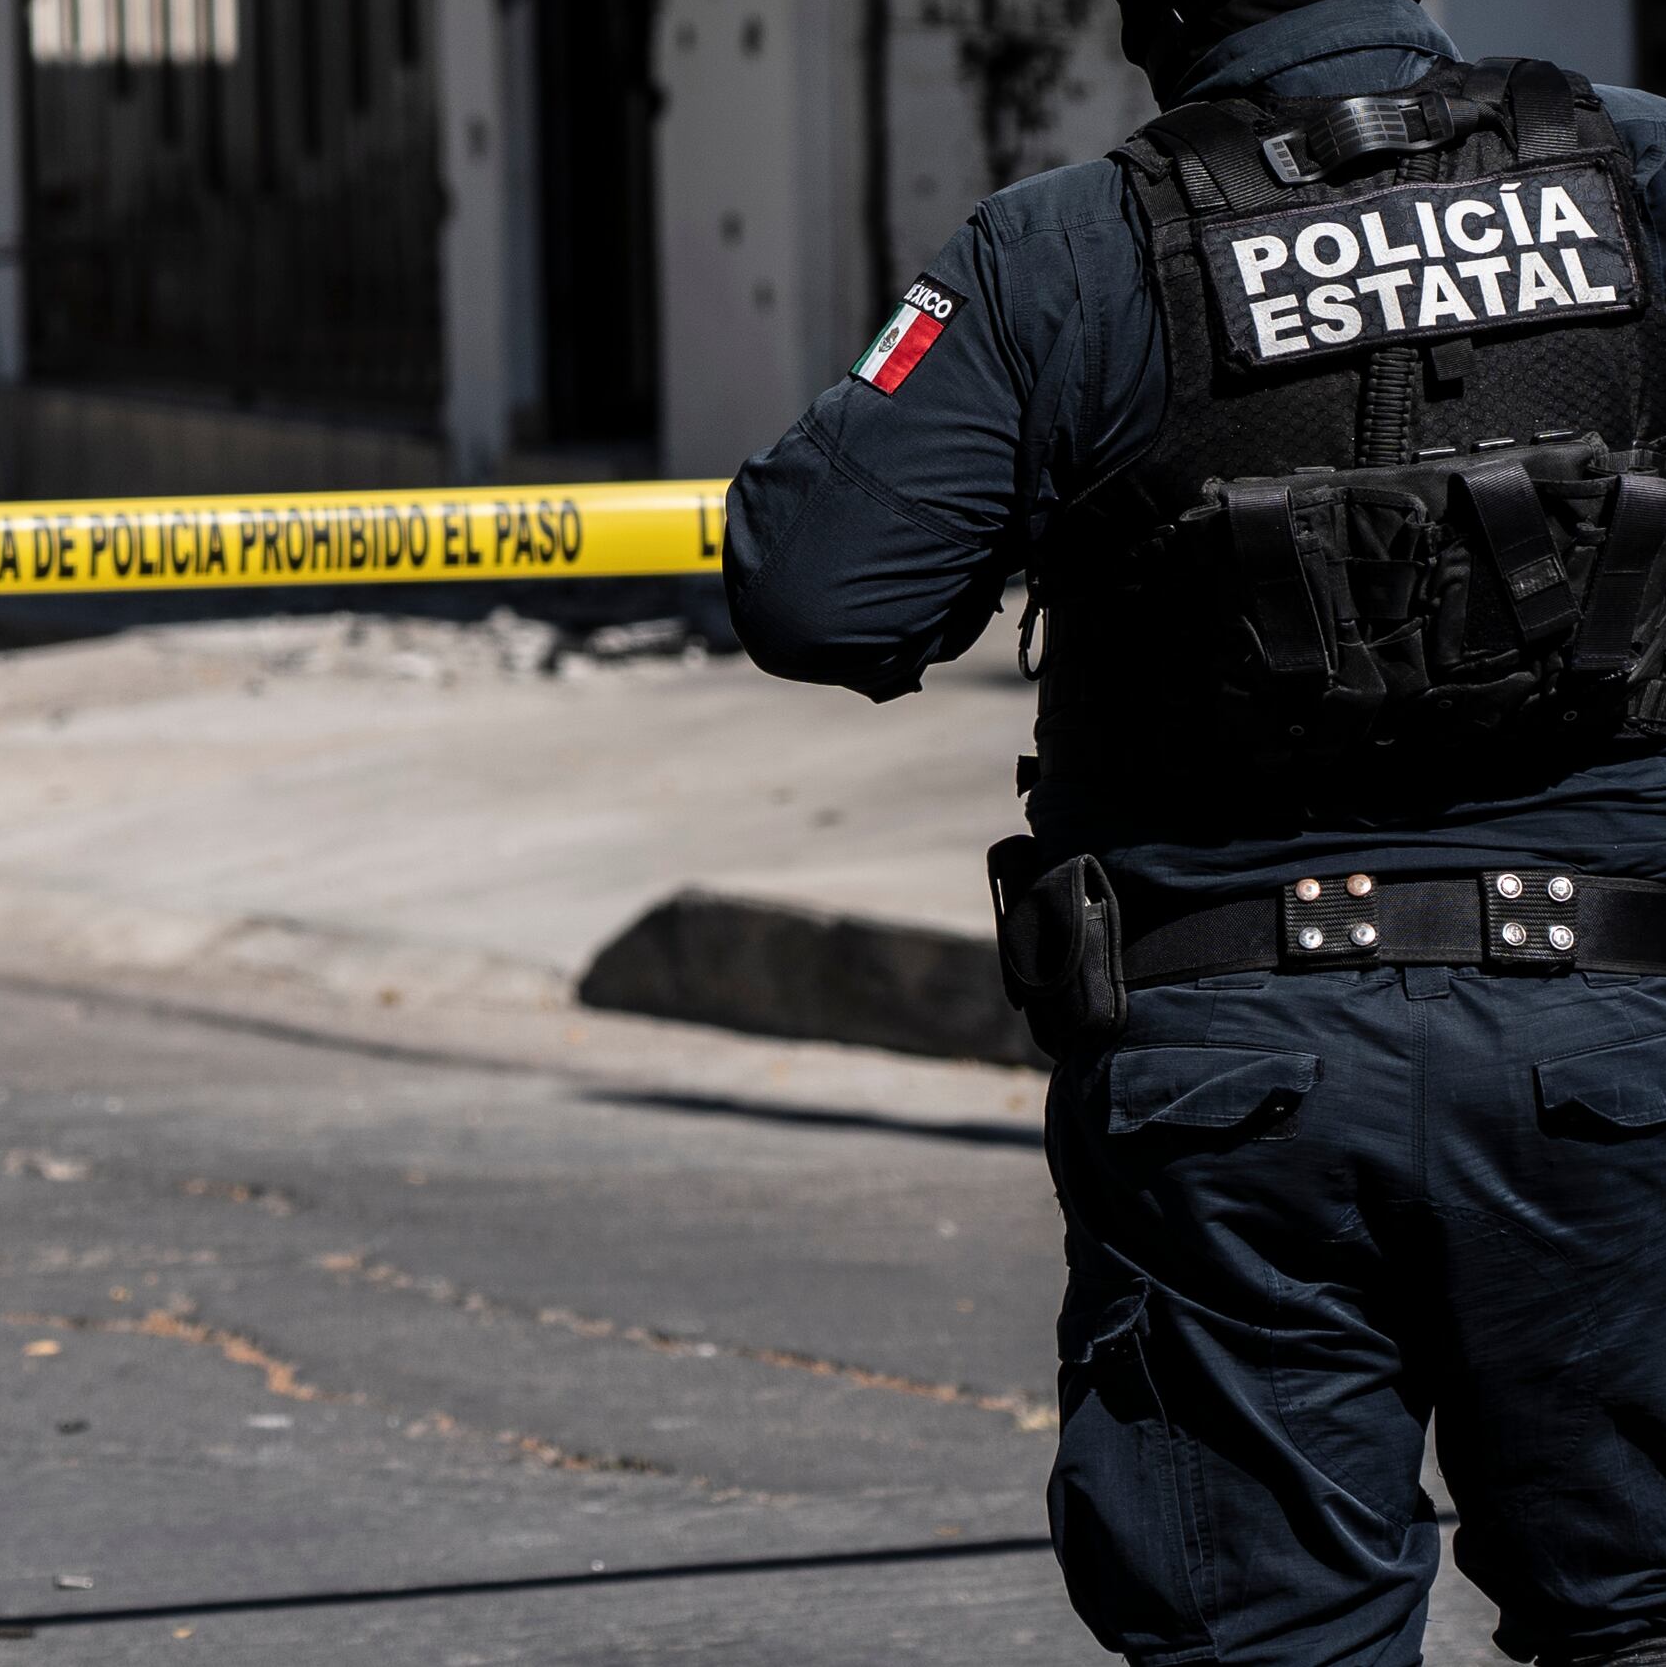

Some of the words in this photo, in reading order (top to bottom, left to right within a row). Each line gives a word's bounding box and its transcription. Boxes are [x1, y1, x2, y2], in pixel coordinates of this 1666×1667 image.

[1232, 182, 1598, 295] POLICÍA
[1249, 248, 1617, 358] ESTATAL
[33, 513, 75, 581] DE
[88, 509, 225, 580] POLICIA
[240, 503, 431, 575] PROHIBIDO
[442, 502, 481, 567] EL
[494, 498, 583, 565] PASO
